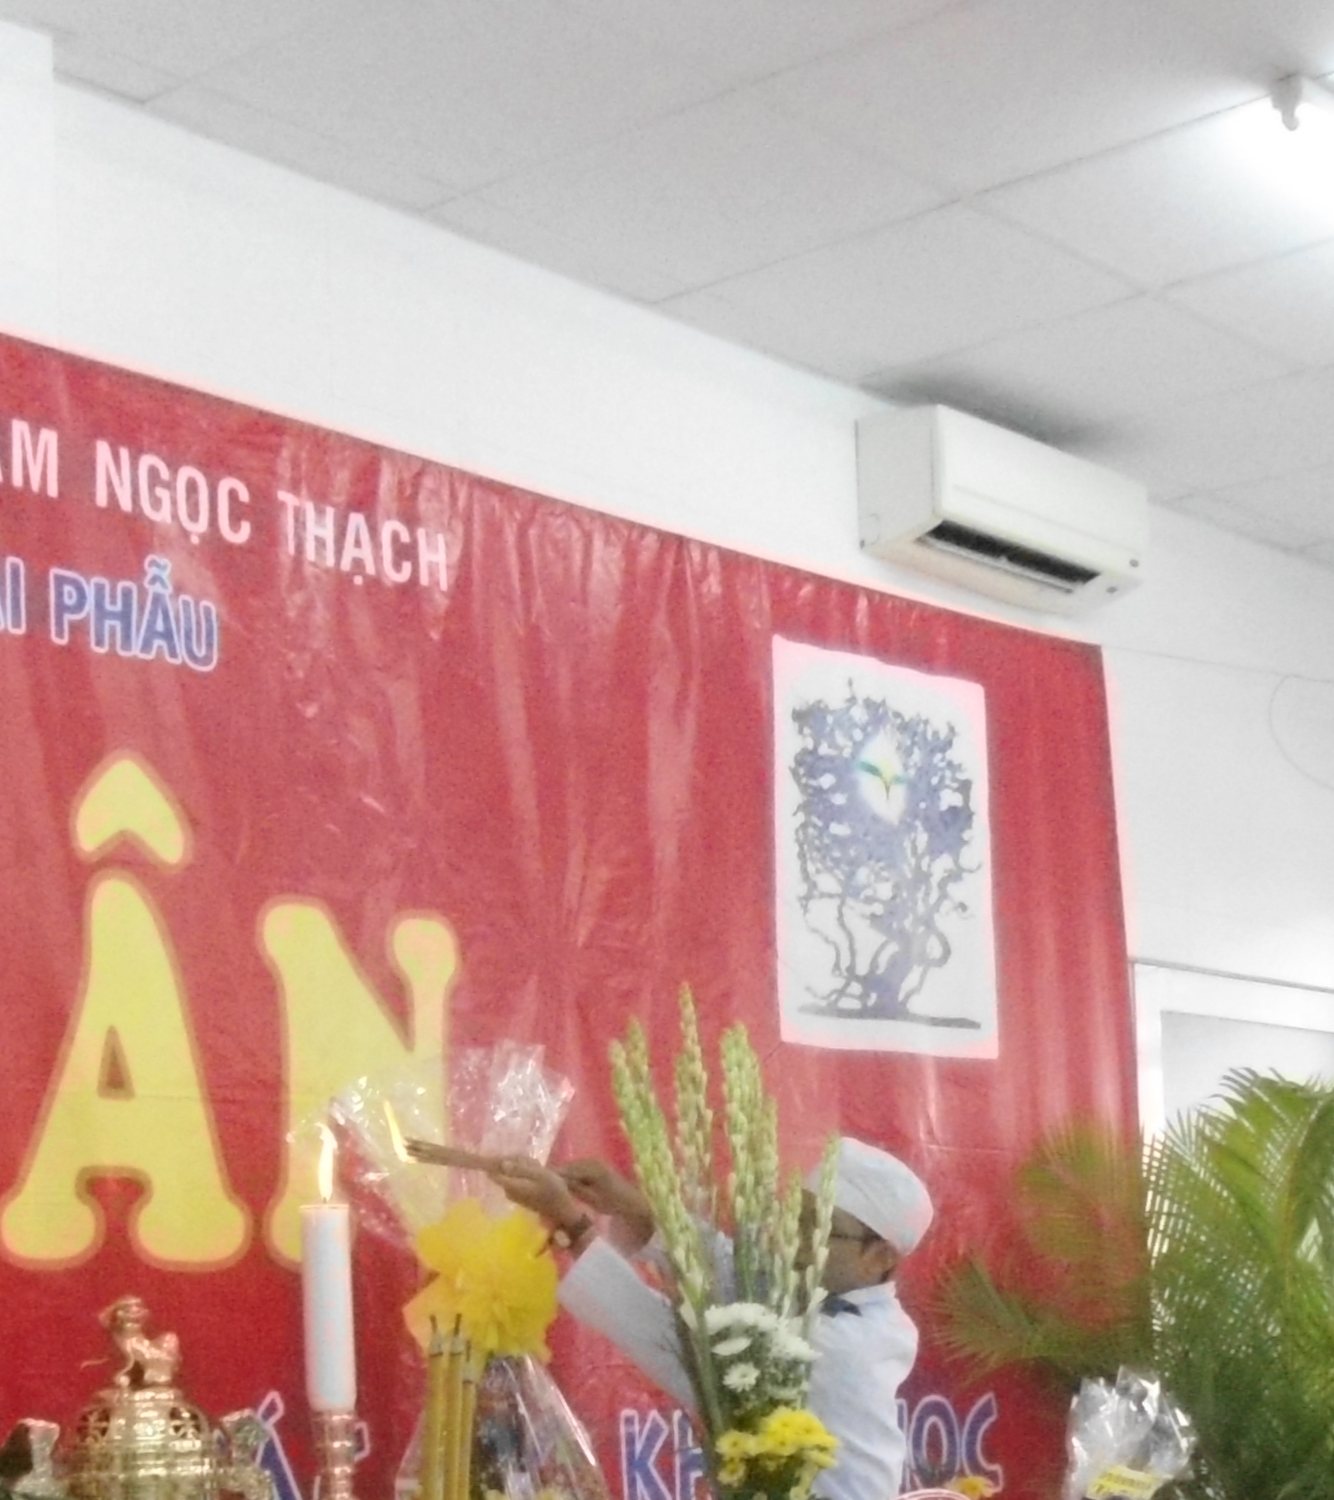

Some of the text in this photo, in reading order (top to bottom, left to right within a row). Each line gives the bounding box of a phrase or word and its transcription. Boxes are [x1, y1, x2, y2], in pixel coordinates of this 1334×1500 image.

[94, 439, 252, 545] NGỌC
[276, 490, 449, 592] THẠCH
[49, 554, 219, 672] PHẪU
